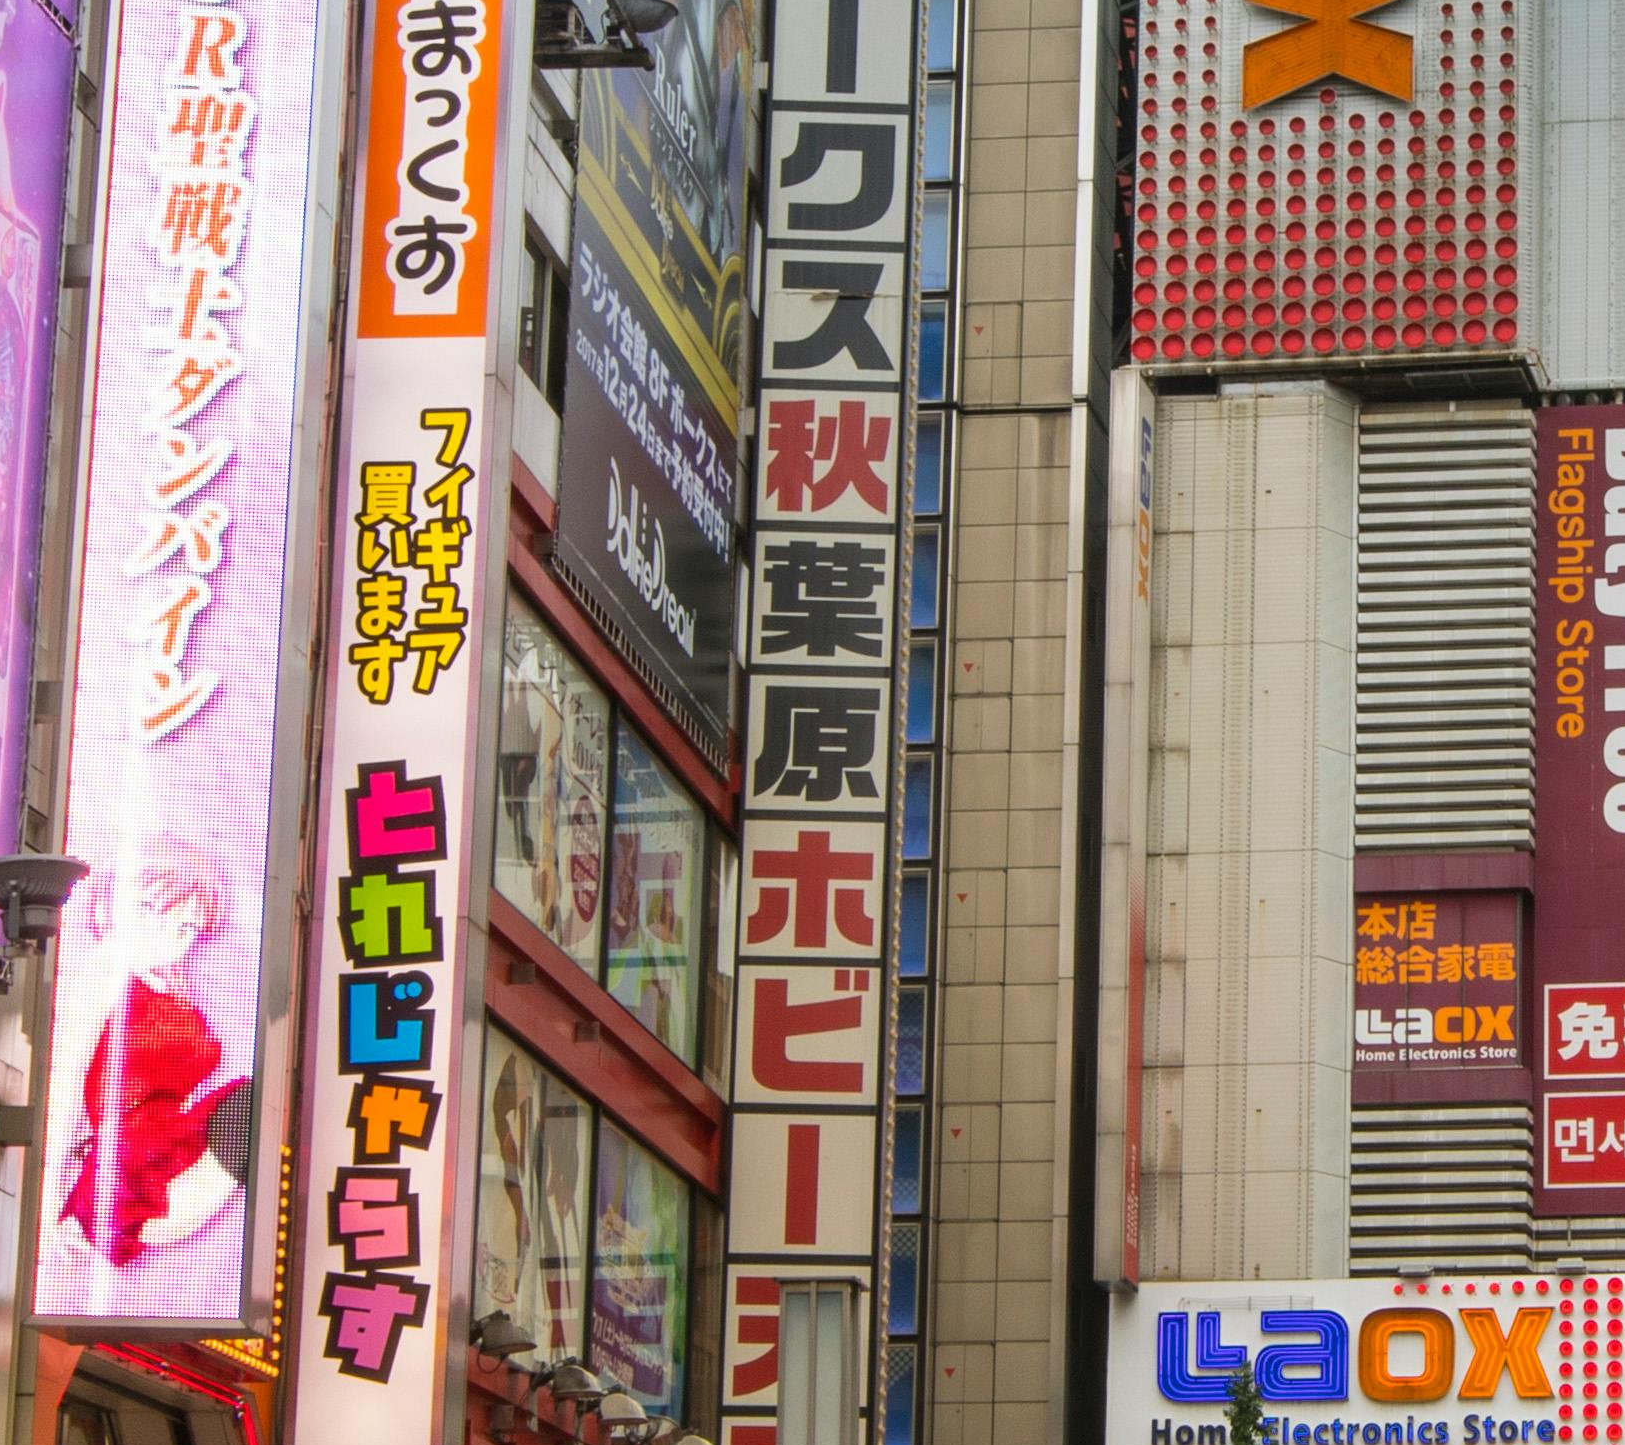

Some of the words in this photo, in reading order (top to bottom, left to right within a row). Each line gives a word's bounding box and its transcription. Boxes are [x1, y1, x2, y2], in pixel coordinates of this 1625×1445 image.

[652, 47, 699, 162] Ruler
[577, 235, 647, 391] ラジオ会館
[648, 339, 668, 419] 8F
[669, 374, 731, 517] ボークスにて
[411, 408, 483, 696] フィギュア
[1547, 427, 1596, 607] Flagship
[350, 460, 414, 705] 買います
[1554, 617, 1596, 740] Store
[1356, 902, 1437, 942] 本店
[1356, 944, 1518, 985] 総合家電
[322, 760, 448, 1385] とれじゃらす
[1356, 1047, 1395, 1062] Home
[1399, 1046, 1476, 1061] Electronics
[1480, 1045, 1518, 1061] Store
[1463, 1413, 1555, 1444] Store
